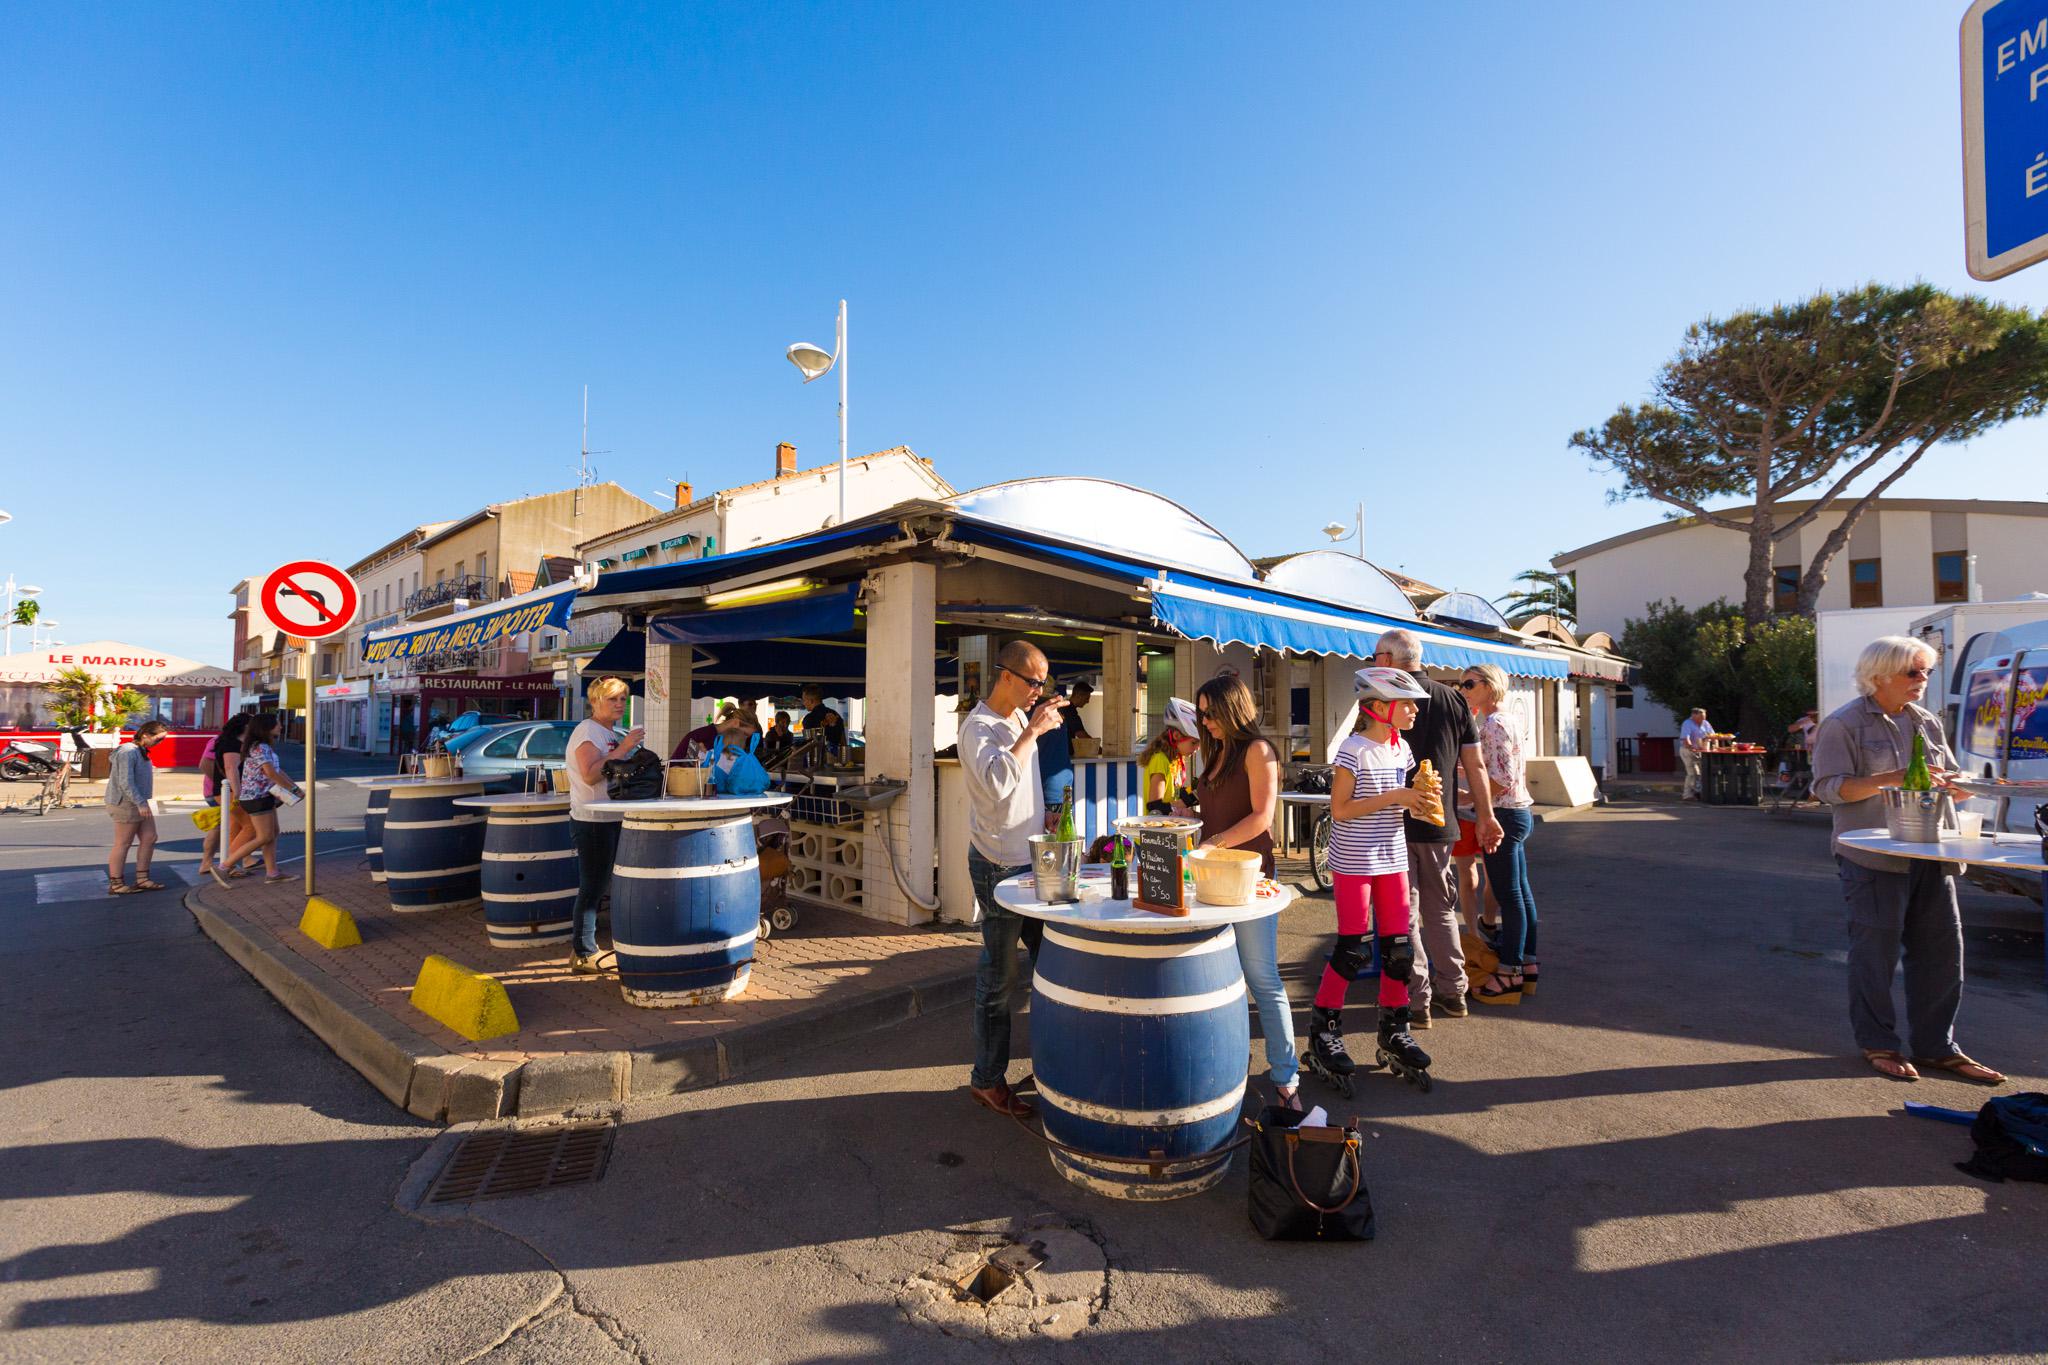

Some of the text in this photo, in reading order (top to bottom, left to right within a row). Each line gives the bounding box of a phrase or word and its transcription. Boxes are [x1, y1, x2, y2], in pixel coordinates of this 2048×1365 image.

[49, 655, 167, 668] LE MARIUS
[147, 675, 232, 686] POISSONS
[425, 678, 503, 690] RESTAURANT
[512, 682, 524, 690] LE
[1141, 850, 1146, 859] 6
